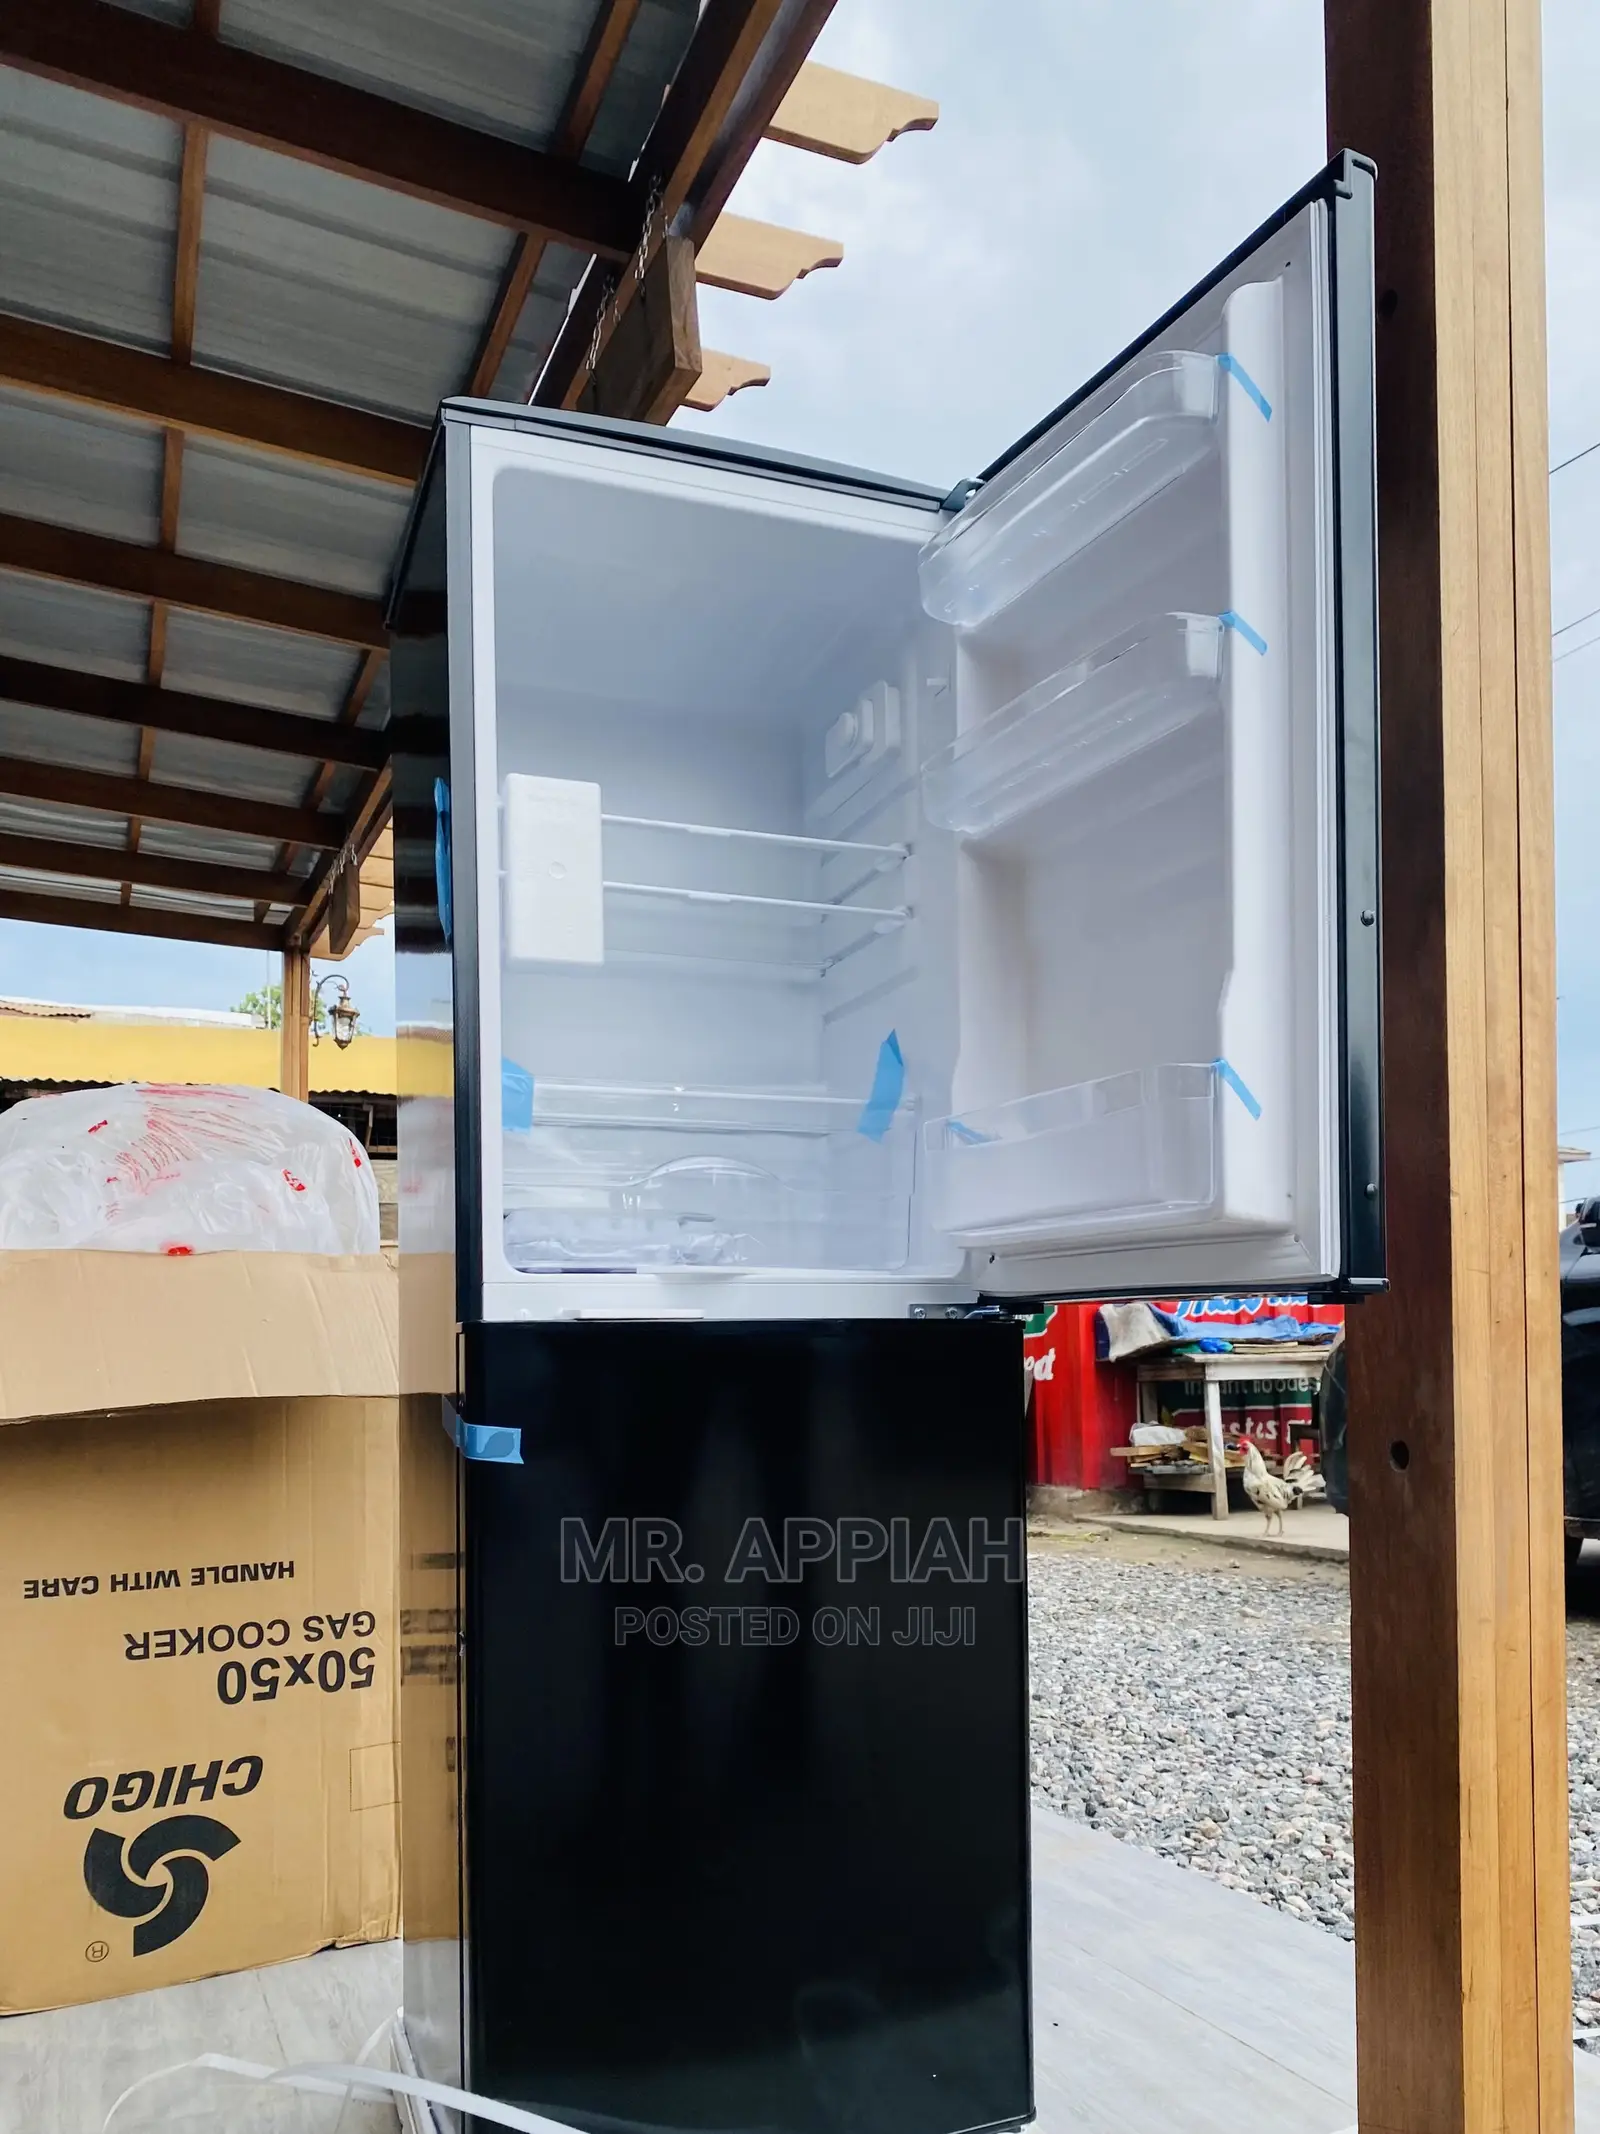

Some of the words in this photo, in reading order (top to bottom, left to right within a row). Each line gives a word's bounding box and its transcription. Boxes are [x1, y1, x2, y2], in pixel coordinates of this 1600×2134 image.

[23, 1574, 99, 1599] CARE
[110, 1568, 181, 1592] WITH
[191, 1560, 295, 1586] HANDLE
[123, 1618, 291, 1661] COOKER
[302, 1610, 376, 1642] GAS
[217, 1646, 376, 1705] 50x50
[63, 1755, 264, 1820] CHIGO
